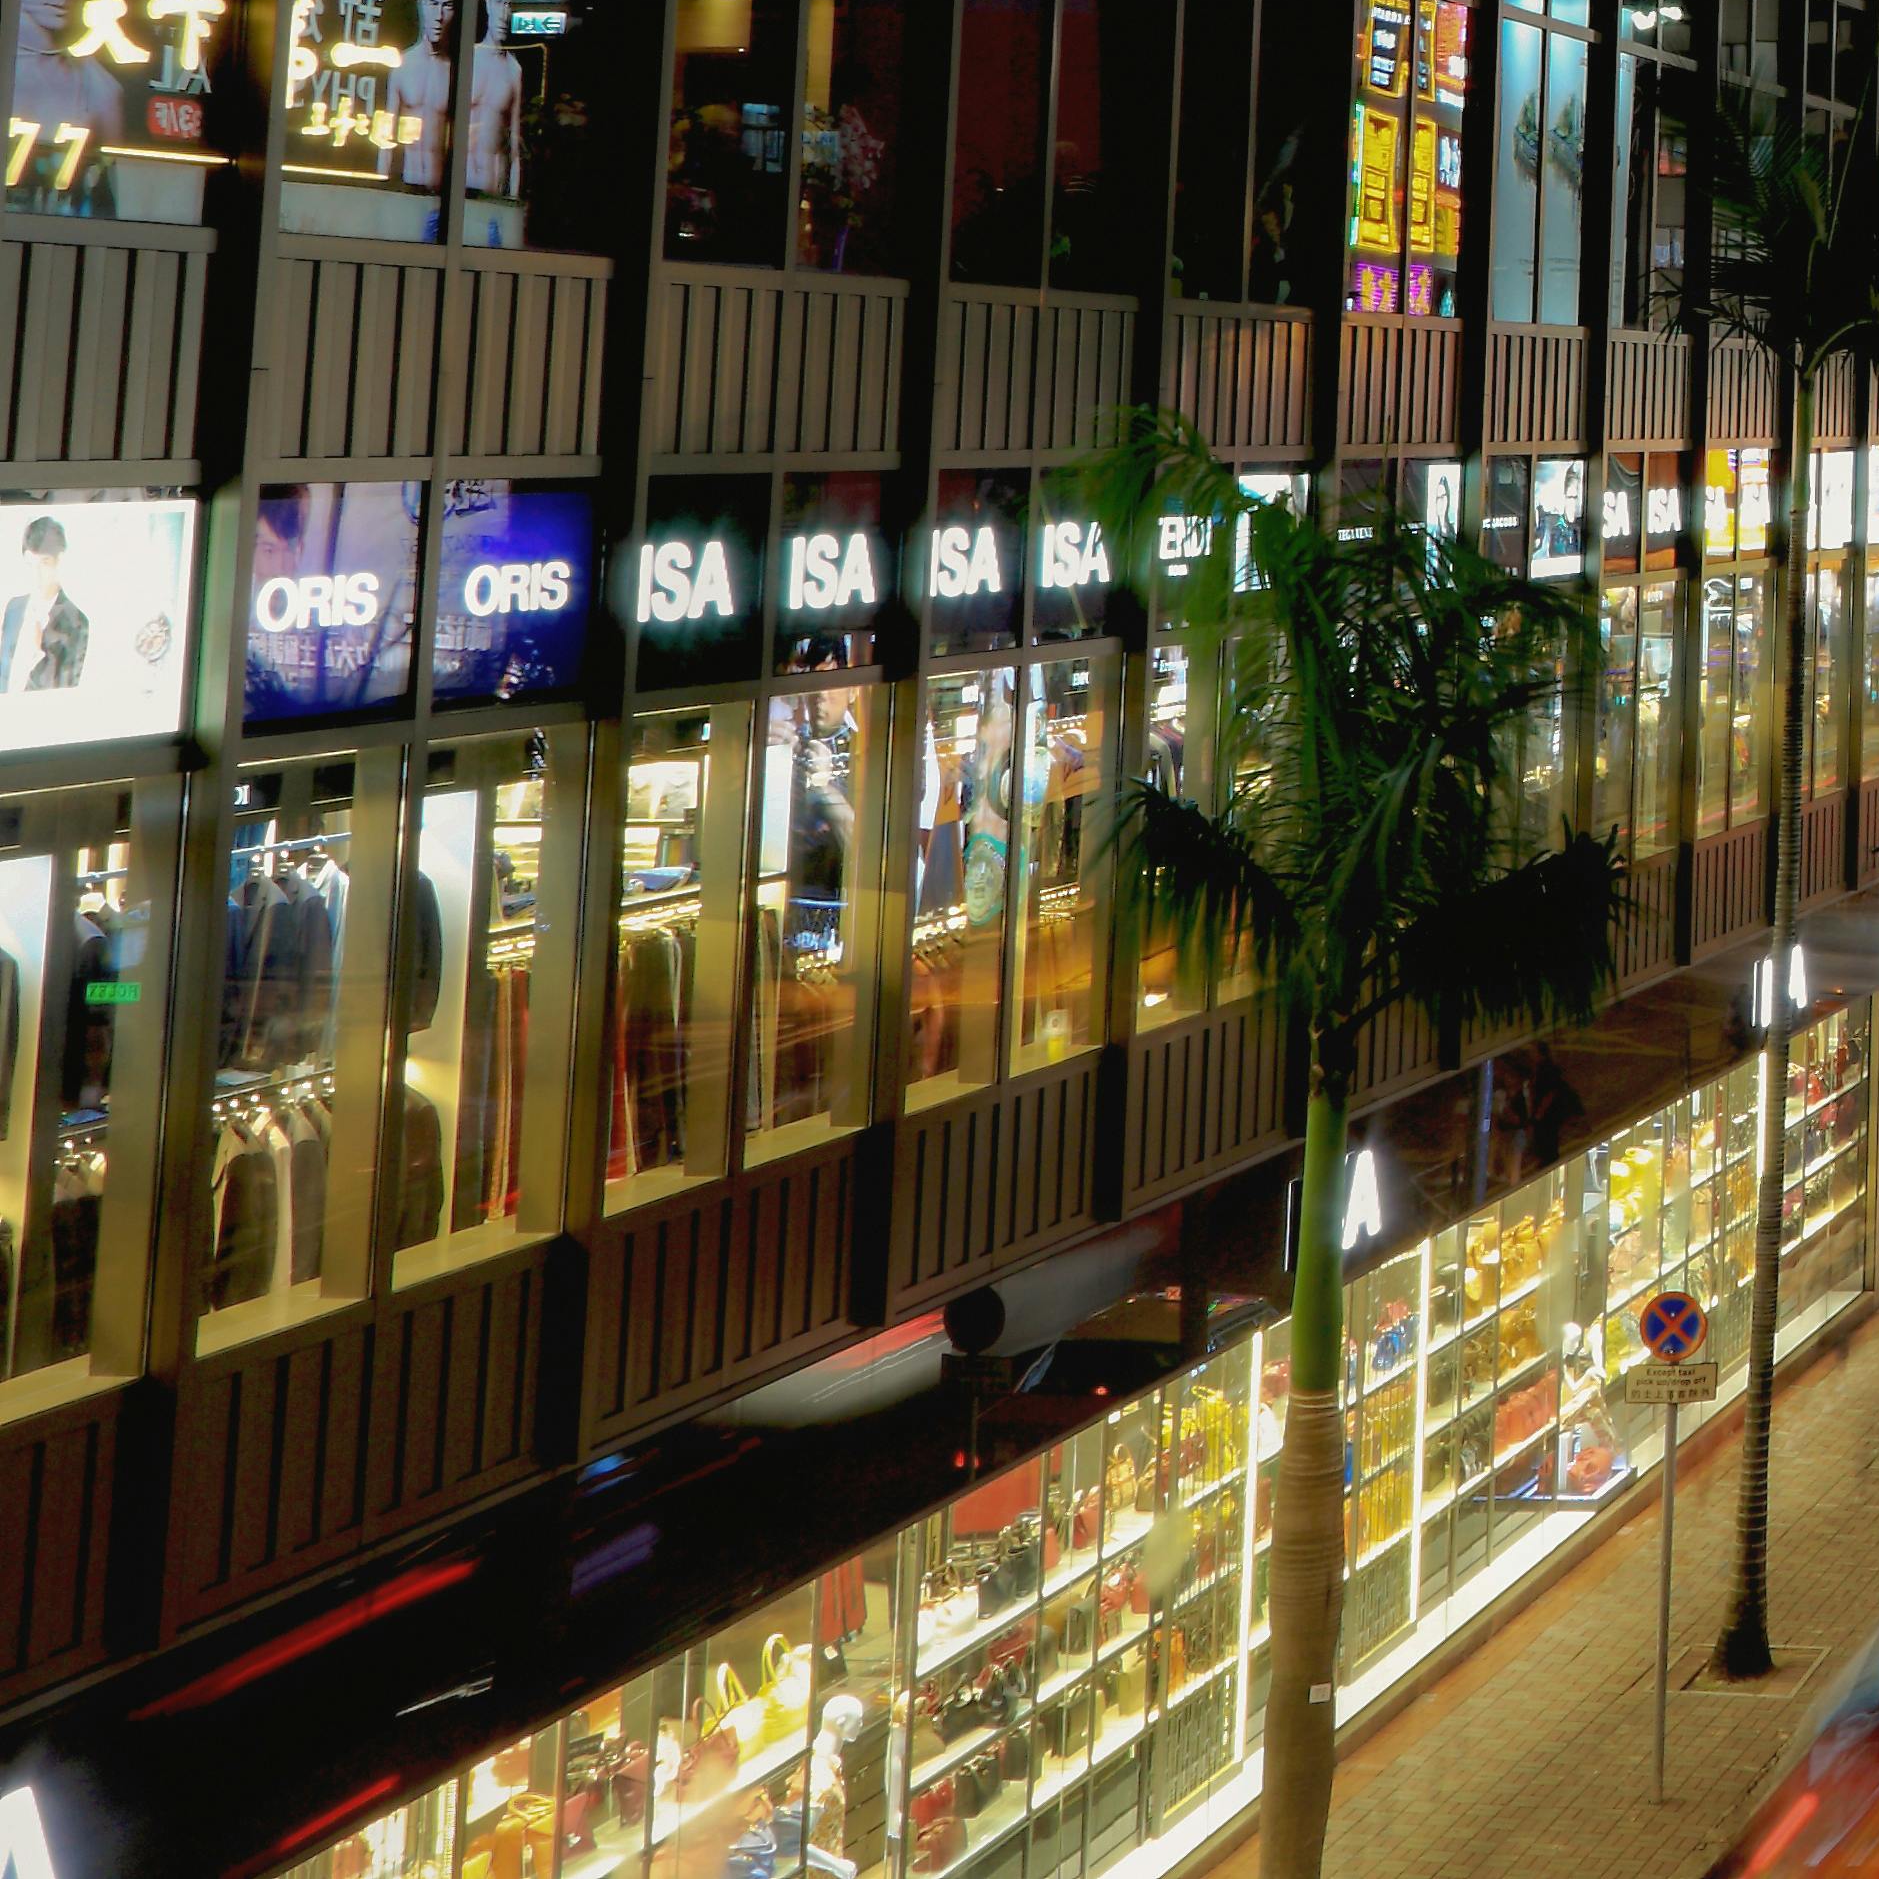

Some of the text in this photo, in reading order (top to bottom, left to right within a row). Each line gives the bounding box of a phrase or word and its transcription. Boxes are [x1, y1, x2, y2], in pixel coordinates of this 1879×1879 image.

[1158, 516, 1212, 560] ENDI
[1602, 491, 1630, 539] SA
[638, 541, 734, 622] ISA
[790, 532, 876, 610] ISA
[929, 527, 1001, 598] ISA
[1042, 521, 1110, 588] ISA
[256, 572, 379, 633] ORIS
[463, 560, 571, 616] ORIS
[1646, 1368, 1696, 1378] Except taxi
